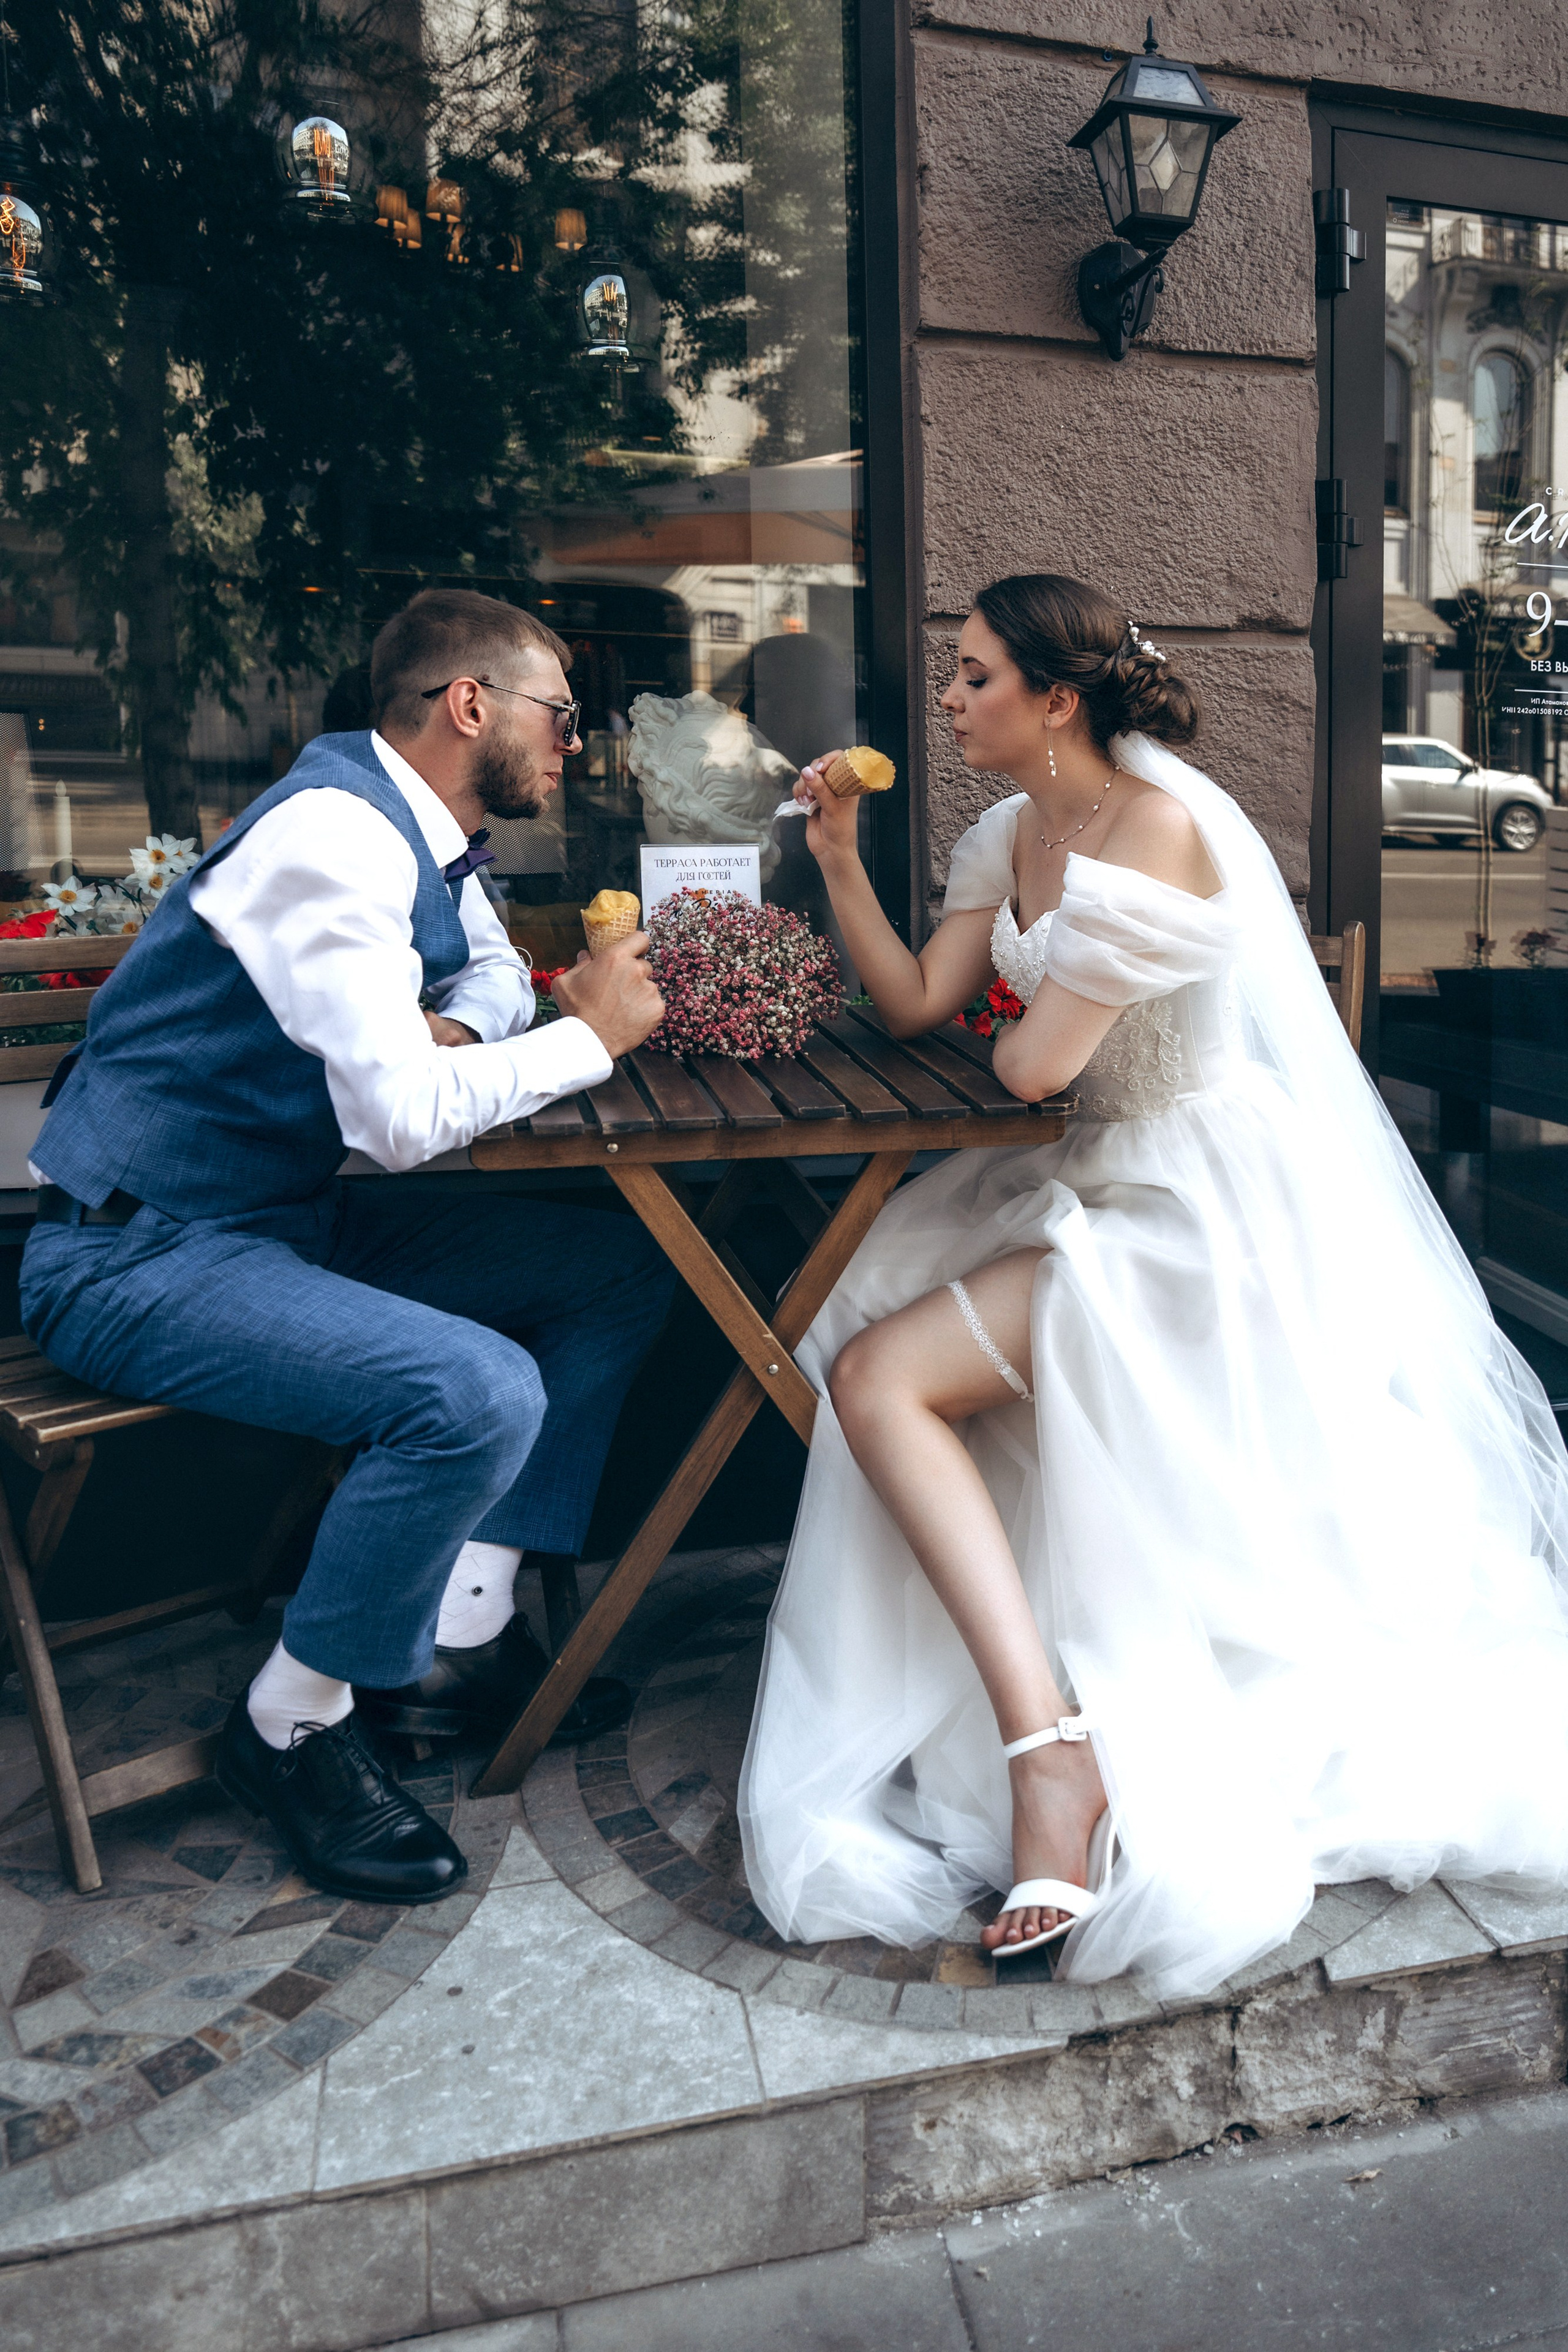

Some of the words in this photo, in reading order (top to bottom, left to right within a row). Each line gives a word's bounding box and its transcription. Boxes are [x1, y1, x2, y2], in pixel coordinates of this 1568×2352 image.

[1531, 660, 1551, 672] БЕЗ
[654, 859, 697, 867] ТЕРРАСА
[700, 858, 750, 867] РАБОТАЕТ
[676, 872, 695, 882] ДЛЯ
[698, 870, 731, 880] ГОСТЕЙ
